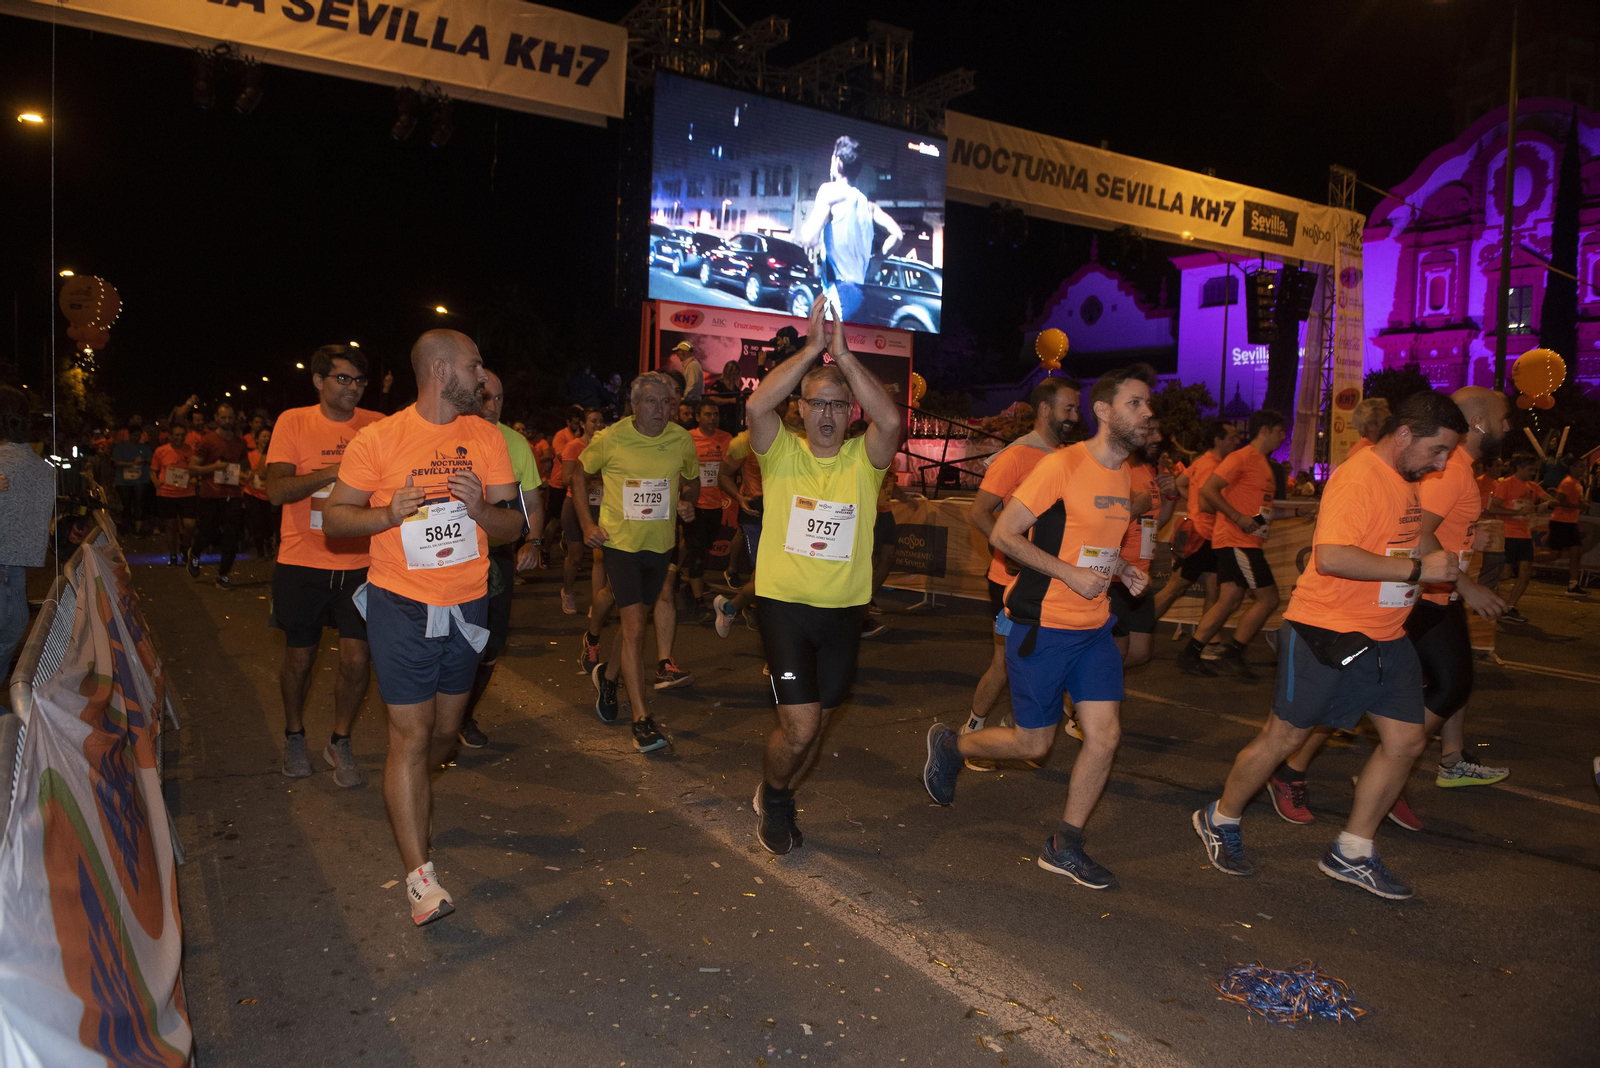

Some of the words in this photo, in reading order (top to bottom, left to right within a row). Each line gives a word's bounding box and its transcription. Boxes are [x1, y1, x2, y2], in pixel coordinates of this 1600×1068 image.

[281, 0, 490, 60] SEVILLA
[951, 138, 1089, 193] NOCTURNA
[1095, 172, 1184, 215] SEVILLA
[712, 317, 727, 326] ABC
[733, 321, 765, 331] Cruzcampo
[430, 459, 473, 467] NOCTURNA
[411, 467, 451, 477] SEVILLA
[703, 469, 717, 477] 7928
[633, 492, 662, 503] 21729
[807, 518, 840, 536] 9757
[425, 522, 462, 543] 5842
